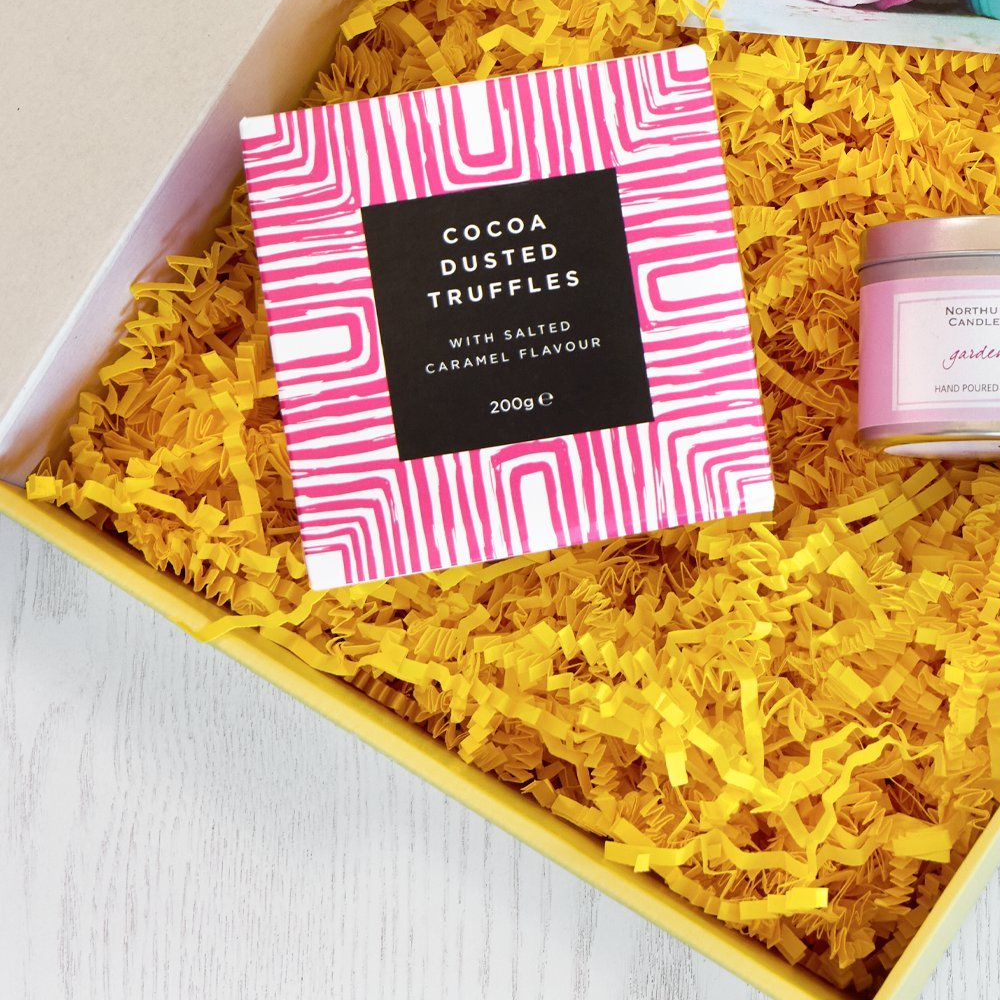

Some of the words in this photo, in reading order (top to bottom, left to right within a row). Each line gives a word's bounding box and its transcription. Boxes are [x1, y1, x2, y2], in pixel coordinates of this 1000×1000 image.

[442, 214, 547, 244] COCOA
[440, 243, 557, 276] DUSTED
[427, 270, 580, 309] TRUFFLES
[449, 333, 494, 349] WITH
[504, 321, 571, 340] SALTED
[425, 352, 510, 374] CARAMEL
[519, 337, 601, 359] FLAVOUR
[934, 384, 960, 393] HAND
[962, 383, 999, 392] POURED
